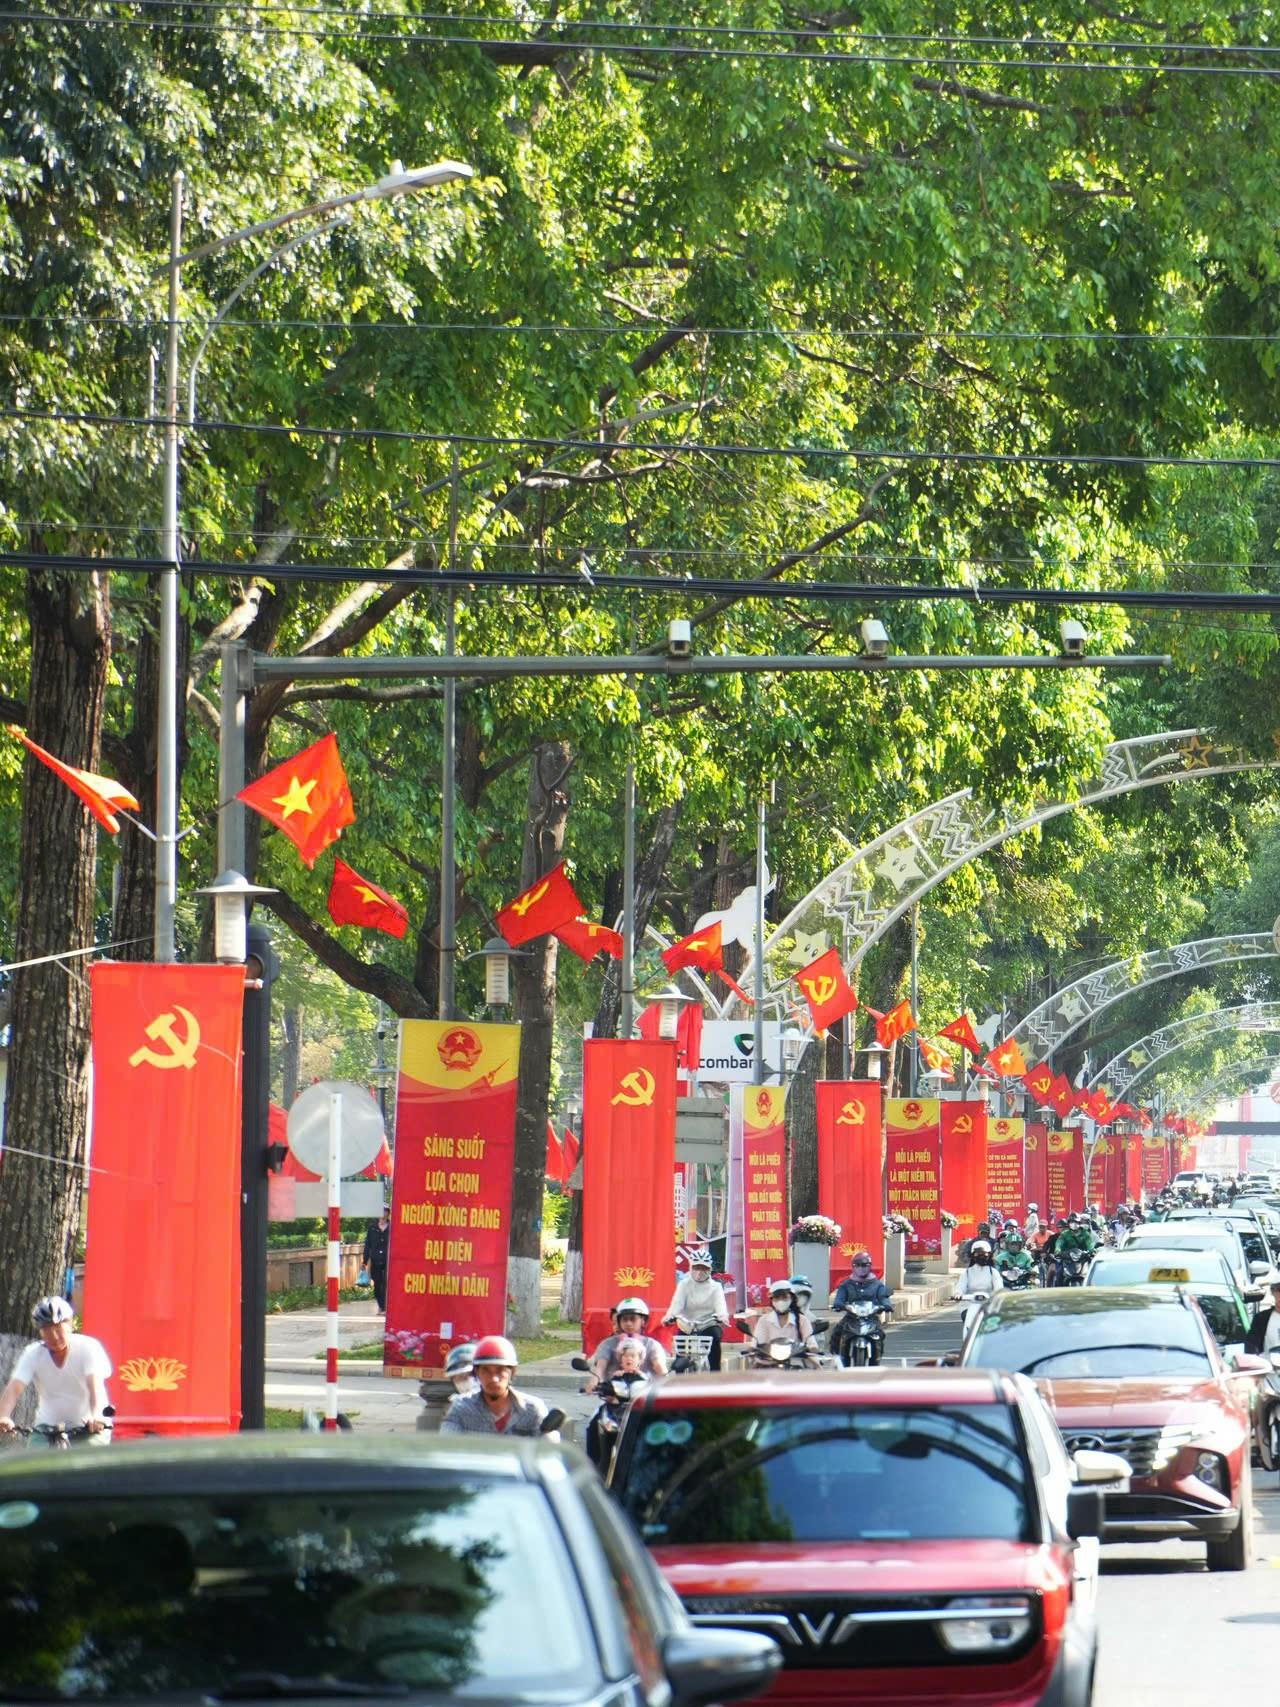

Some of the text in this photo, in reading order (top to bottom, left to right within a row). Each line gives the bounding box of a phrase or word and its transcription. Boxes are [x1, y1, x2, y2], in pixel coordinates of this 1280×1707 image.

[424, 1133, 485, 1159] SÁNG SUỐT
[426, 1171, 479, 1197] LỰA CHỌN
[401, 1201, 500, 1229] NGƯỜI XỨNG ĐÁNG
[425, 1238, 472, 1266] ĐẠI DIỆN
[404, 1272, 489, 1297] CHO NHÂN DÂN!
